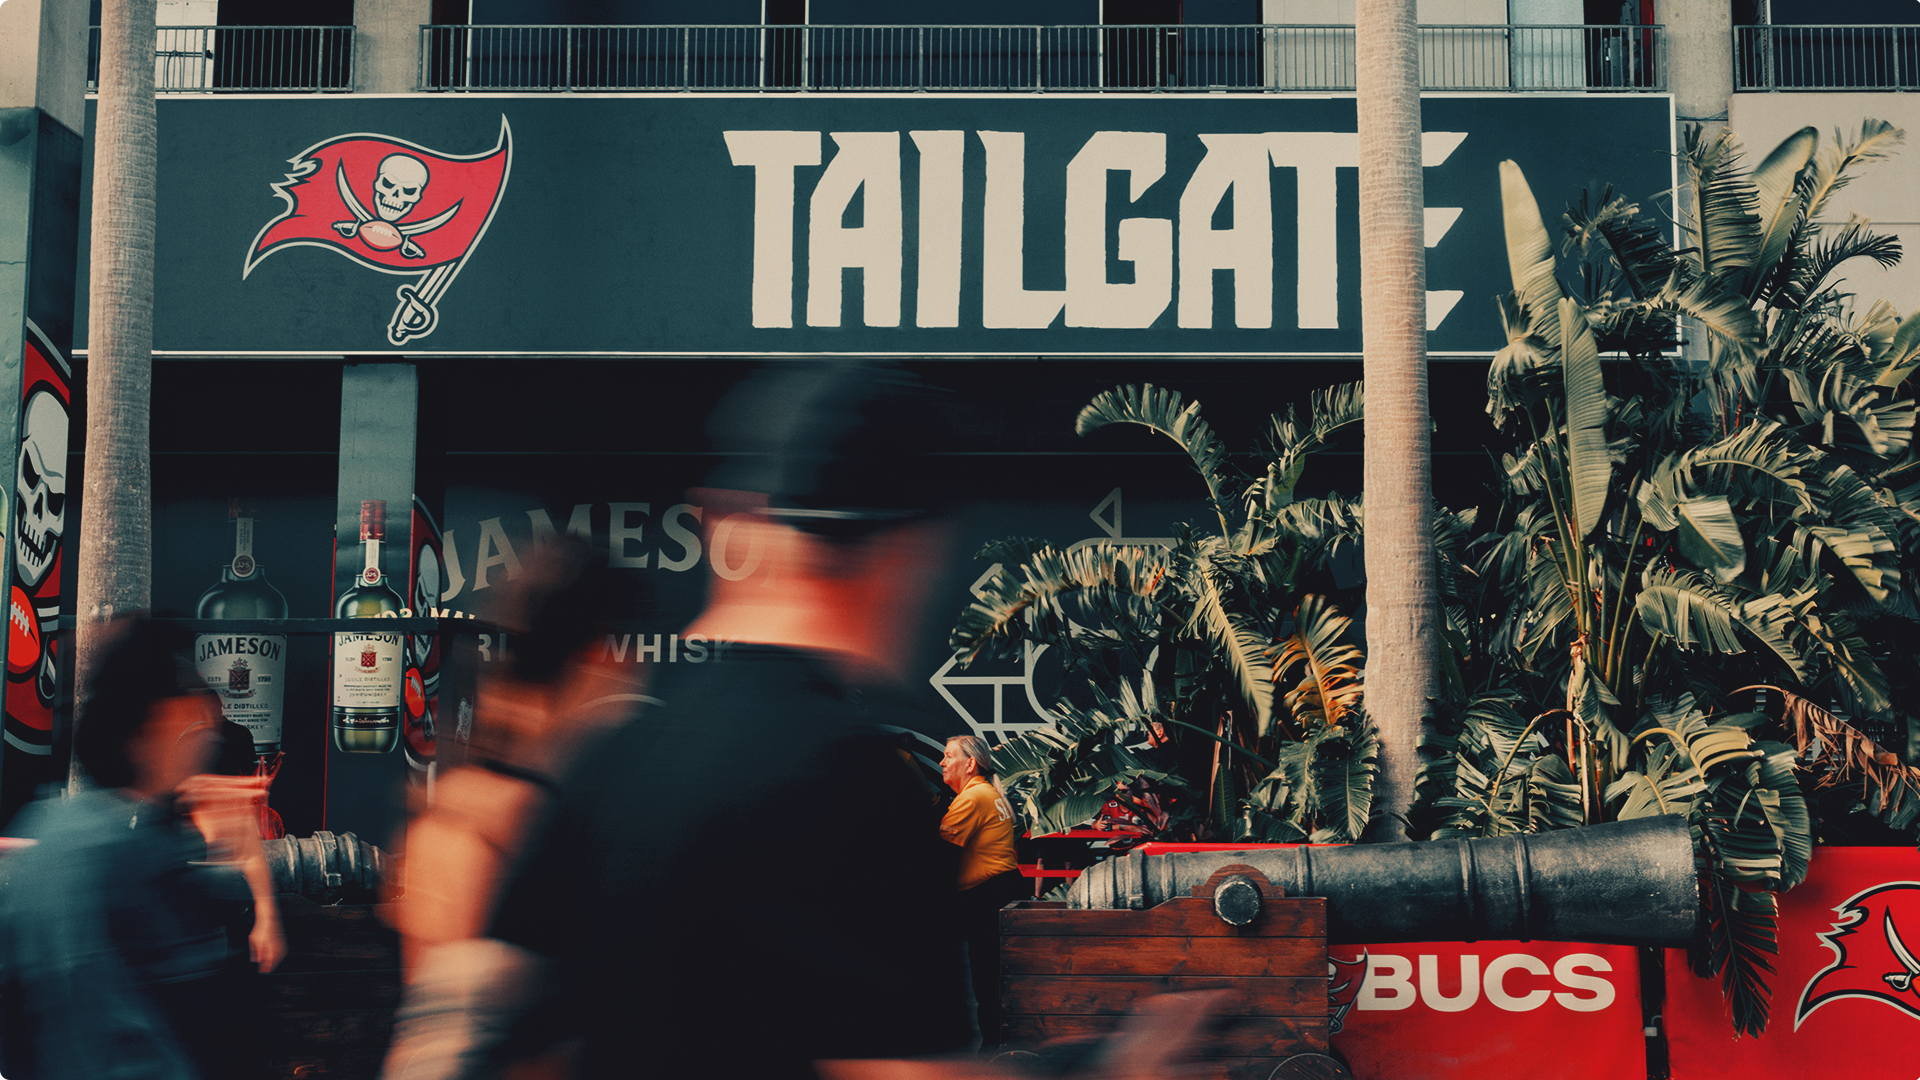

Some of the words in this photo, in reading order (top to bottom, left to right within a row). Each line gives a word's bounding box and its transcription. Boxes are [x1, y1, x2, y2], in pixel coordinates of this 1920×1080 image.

[441, 501, 774, 602] JAMESO
[200, 637, 281, 661] JAMESON
[1356, 953, 1616, 1012] BUCS
